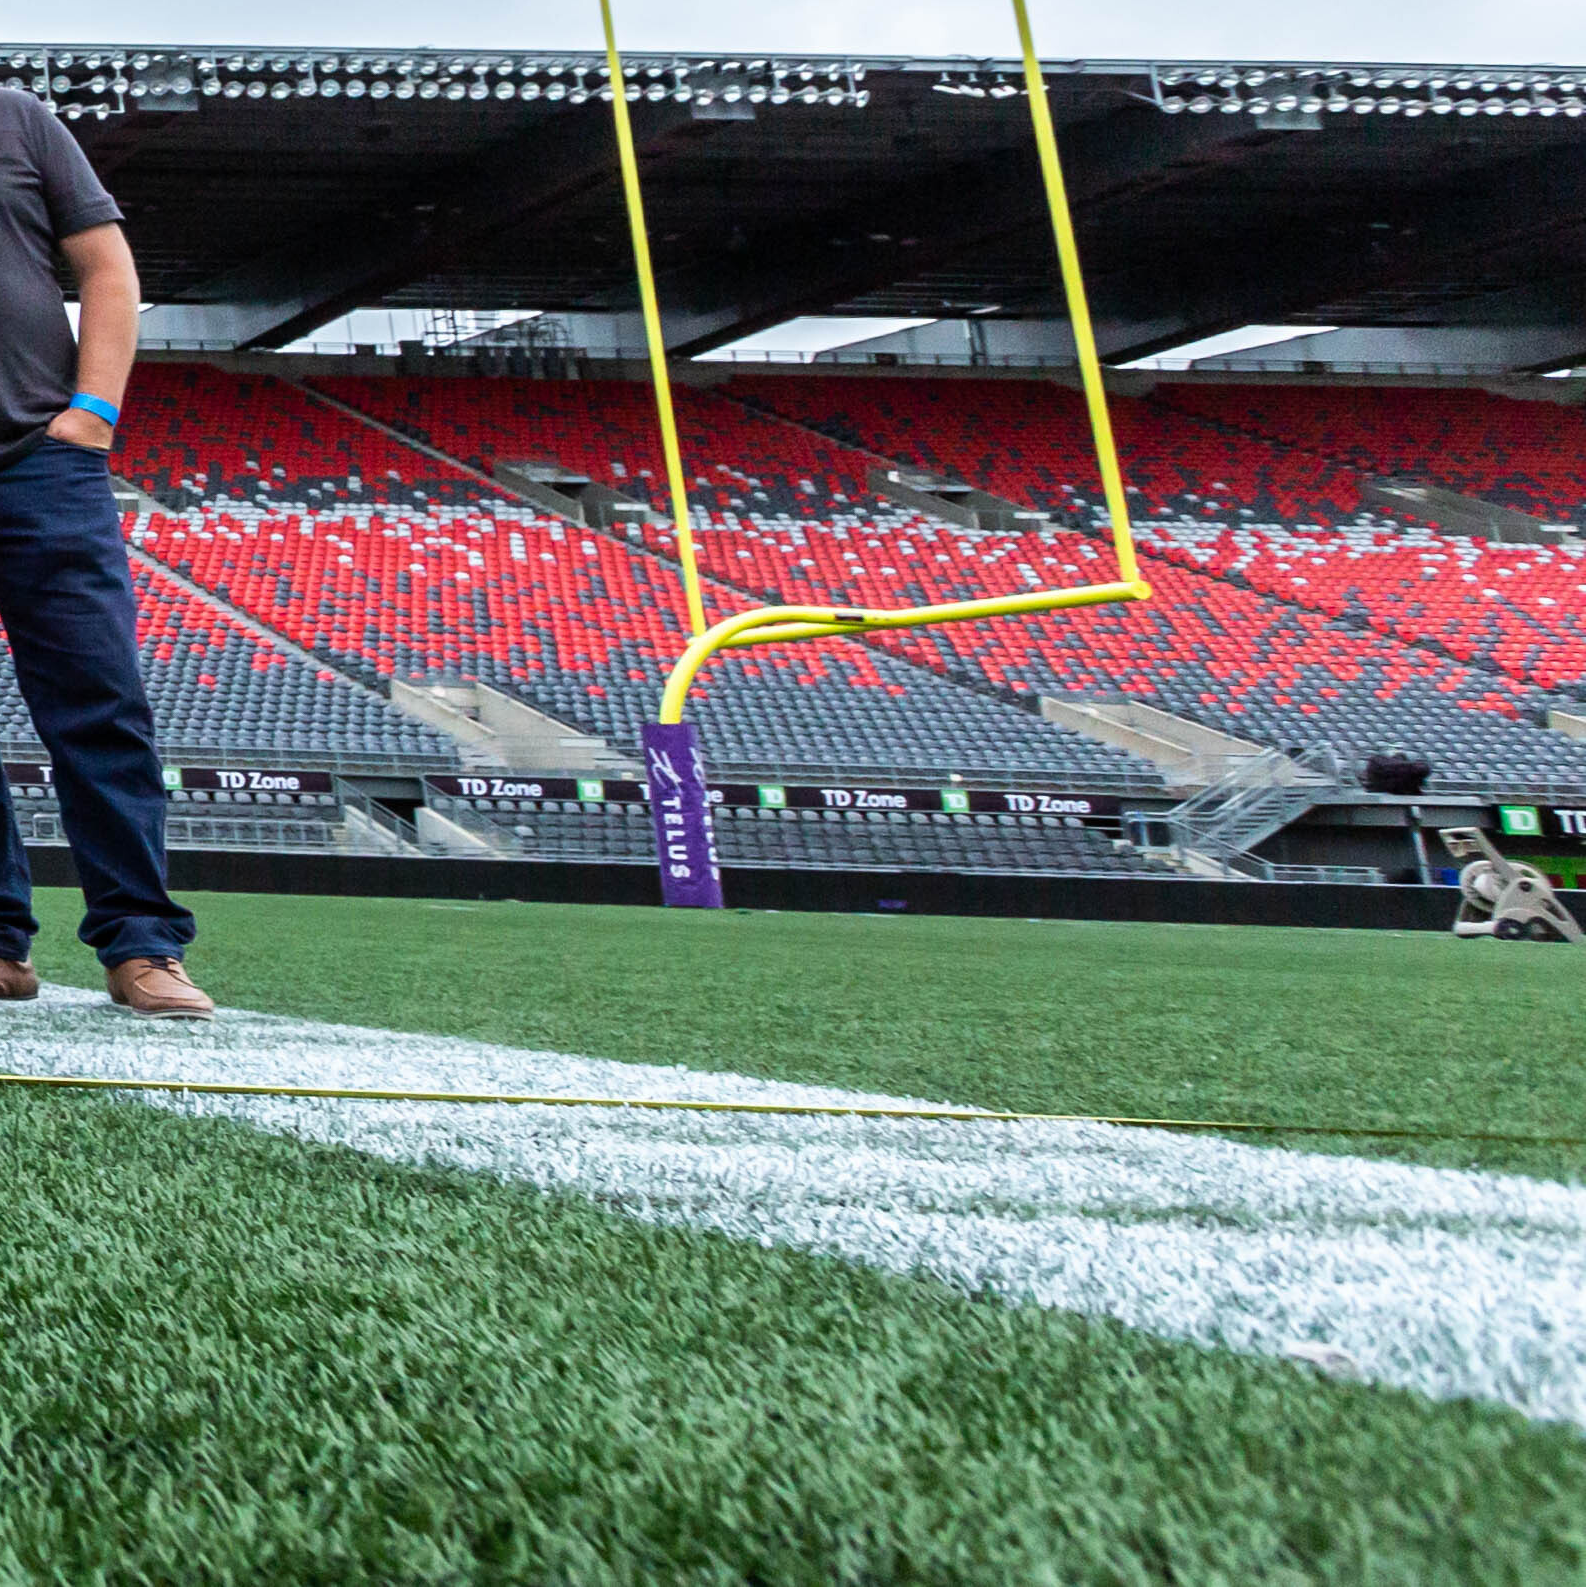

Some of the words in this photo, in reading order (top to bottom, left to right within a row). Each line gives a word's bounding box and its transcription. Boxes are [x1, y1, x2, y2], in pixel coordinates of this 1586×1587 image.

[215, 771, 246, 788] TD
[248, 772, 300, 790] Zone
[457, 778, 488, 795] TD
[490, 779, 543, 796] Zone
[582, 781, 602, 798] TD
[761, 788, 783, 804] TD
[820, 789, 852, 806] TD
[853, 790, 907, 808] Zone
[944, 793, 967, 808] TD
[1003, 794, 1036, 812] TD
[1036, 795, 1092, 813] Zone
[1504, 809, 1536, 831] TD
[661, 796, 691, 878] TELUS
